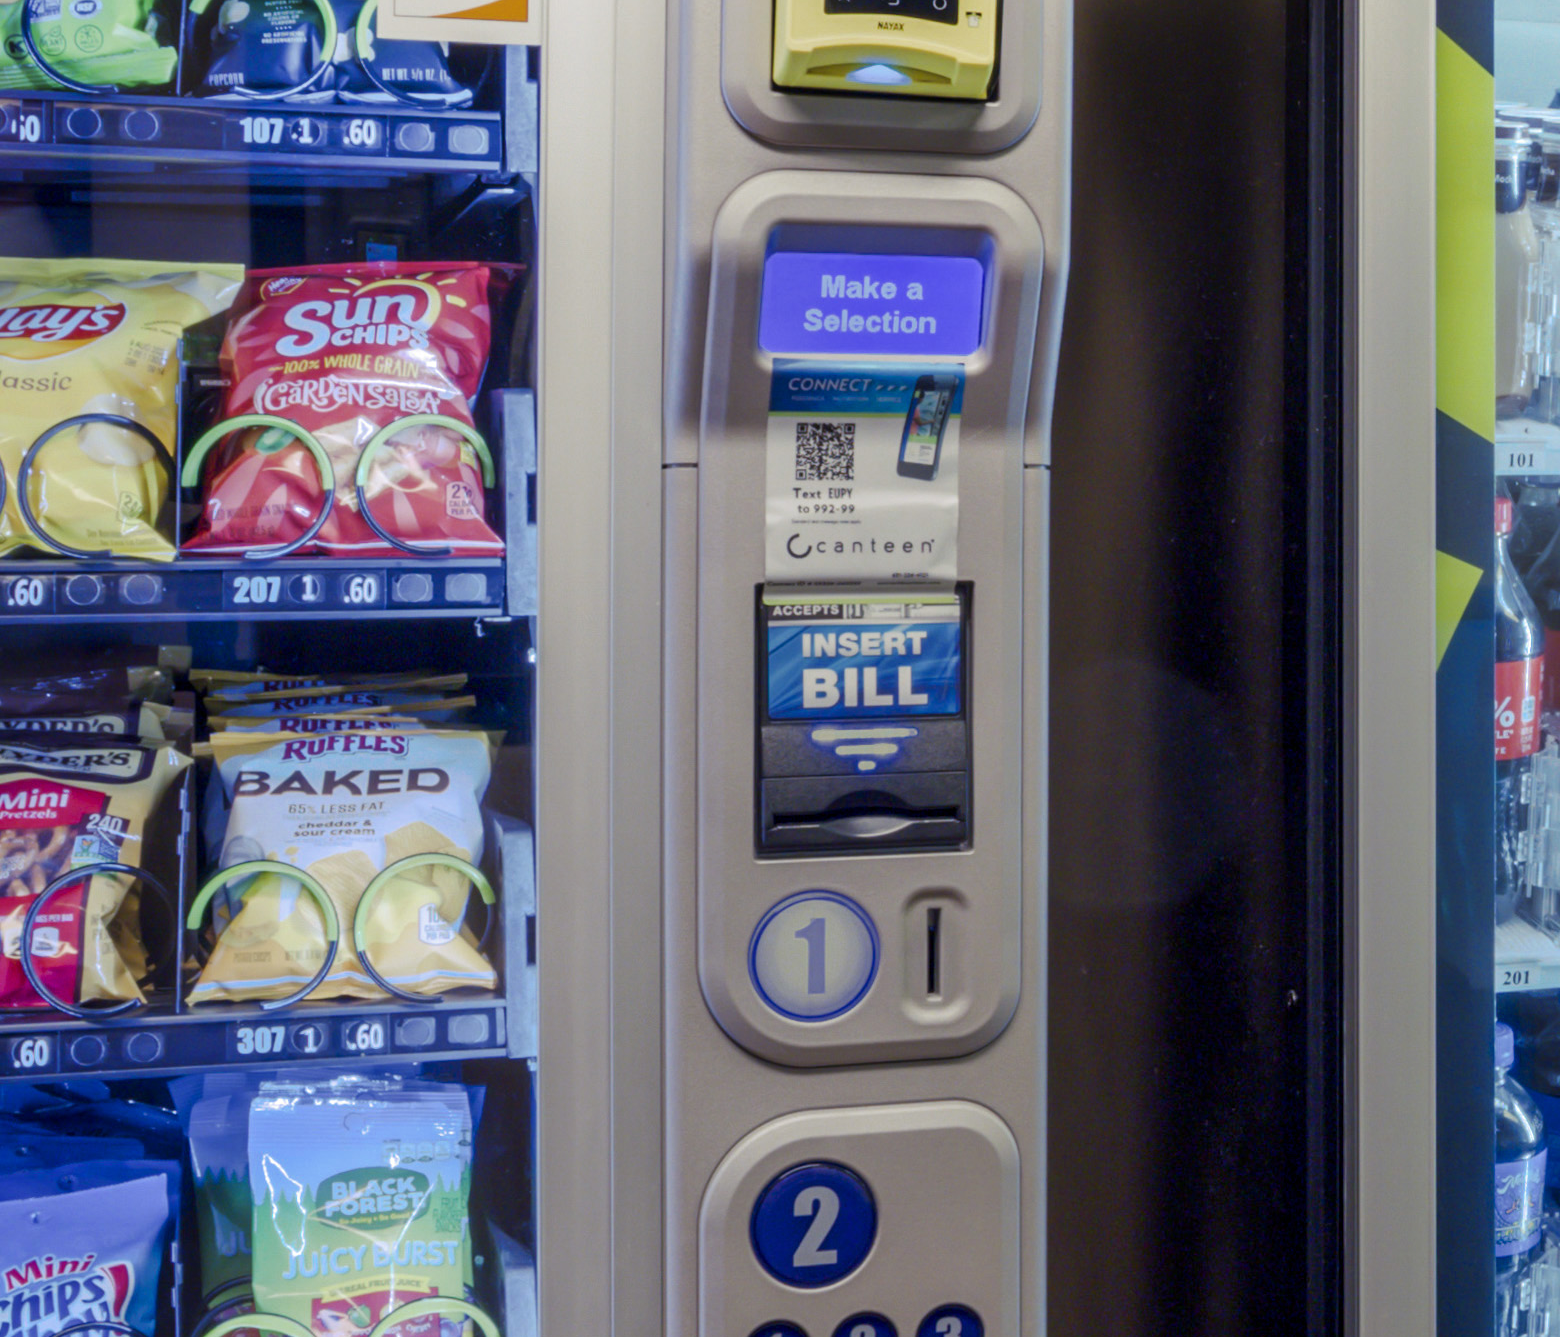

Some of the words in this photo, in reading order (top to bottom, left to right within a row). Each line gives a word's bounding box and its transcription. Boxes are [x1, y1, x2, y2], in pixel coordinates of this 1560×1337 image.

[877, 21, 905, 33] NAYAX
[239, 117, 284, 144] 107
[820, 274, 897, 300] Make
[906, 281, 924, 300] a
[275, 294, 431, 357] Sun
[802, 308, 937, 335] Selection
[331, 323, 430, 350] CHIPS
[283, 358, 321, 375] 100%
[324, 354, 370, 372] WHOLE
[373, 358, 420, 379] GRAIN
[788, 377, 872, 393] CONNECT
[1507, 452, 1535, 467] 101
[792, 487, 822, 500] Text
[828, 487, 854, 500] EUPY
[797, 504, 809, 514] to
[814, 503, 855, 514] 992-99
[816, 537, 935, 554] canteen
[233, 575, 281, 604] 207
[772, 603, 840, 617] ACCEPTS
[801, 630, 928, 657] INSERT
[802, 665, 929, 710] BILL
[281, 733, 410, 761] RUFFLES
[234, 767, 450, 797] BAKED
[288, 803, 317, 815] 65%
[320, 802, 356, 814] LESS
[360, 800, 385, 813] FAT
[293, 827, 331, 838] sour
[333, 826, 376, 837] cream
[298, 819, 360, 831] cheddar
[794, 917, 827, 995] 1
[1502, 969, 1531, 986] 201
[236, 1026, 286, 1055] 307
[331, 1175, 417, 1200] BLACK
[326, 1191, 426, 1218] FOREST
[792, 1185, 841, 1268] 2
[373, 1239, 460, 1268] BURST
[4, 1253, 96, 1291] Mini
